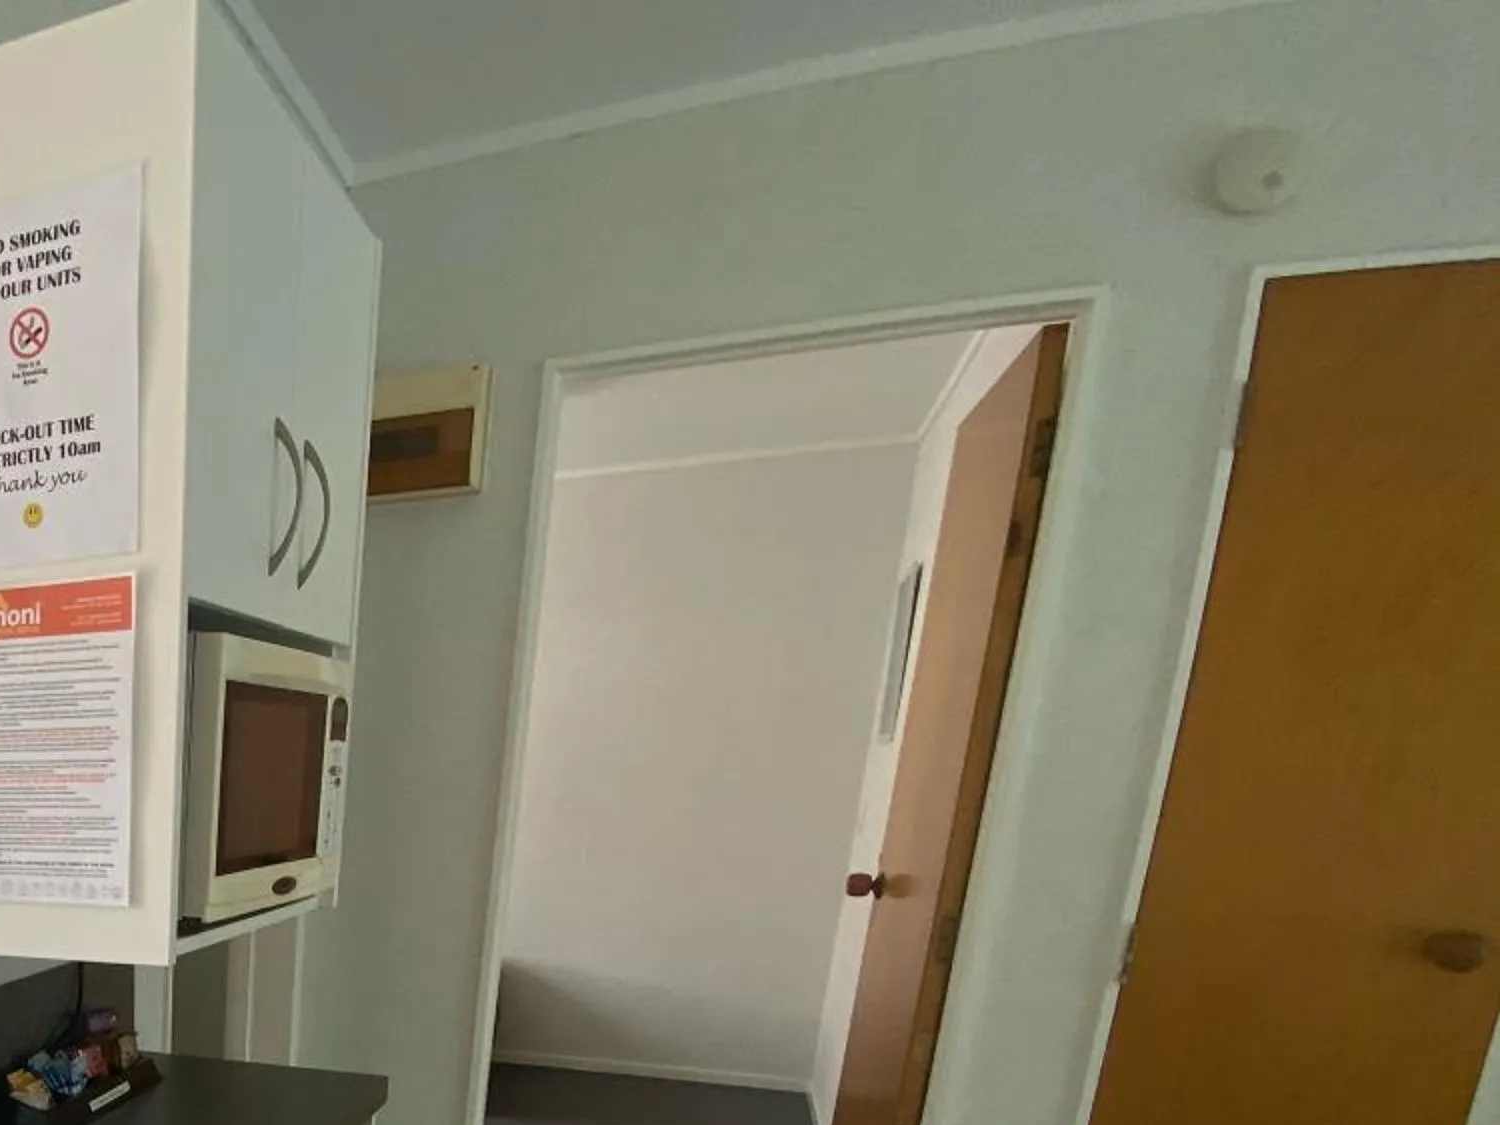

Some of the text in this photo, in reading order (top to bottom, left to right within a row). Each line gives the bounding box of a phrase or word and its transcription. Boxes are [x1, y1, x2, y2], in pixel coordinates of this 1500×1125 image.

[9, 219, 81, 252] SMOKING
[17, 245, 72, 272] VAPING
[0, 280, 31, 300] OUR
[36, 266, 81, 291] UNITS
[57, 413, 95, 435] TIME
[60, 441, 101, 459] 10am
[47, 469, 88, 493] you
